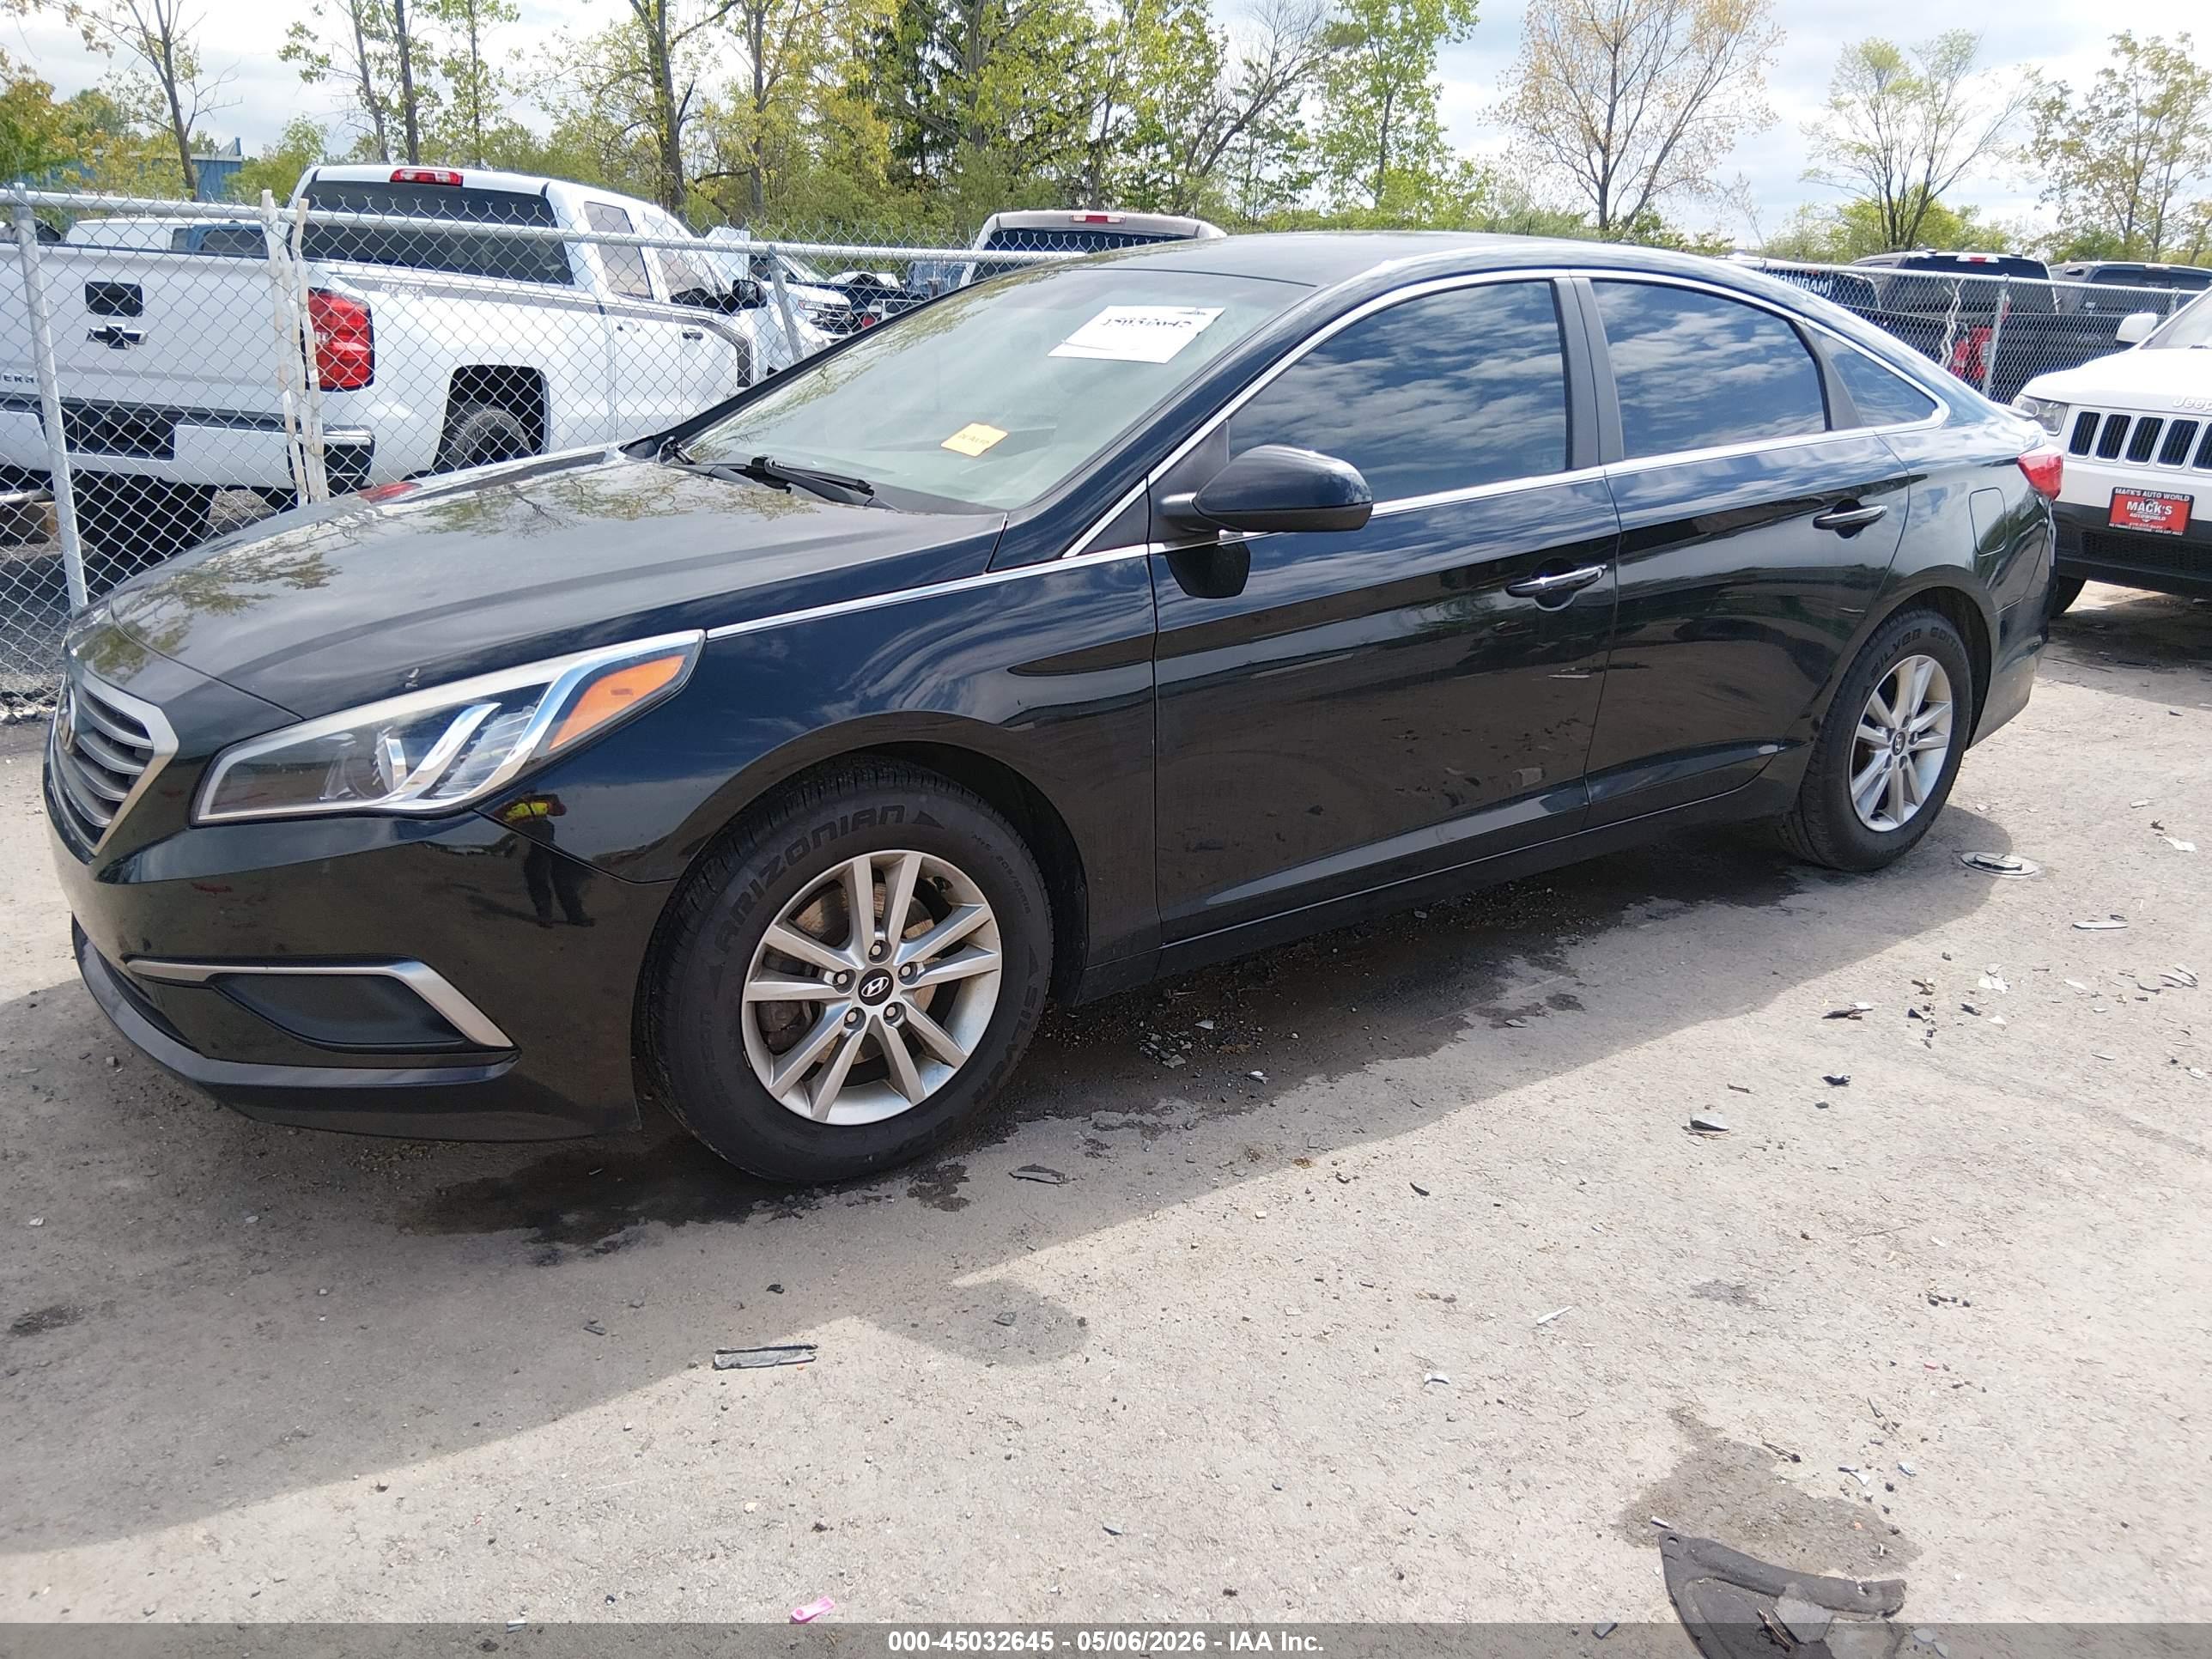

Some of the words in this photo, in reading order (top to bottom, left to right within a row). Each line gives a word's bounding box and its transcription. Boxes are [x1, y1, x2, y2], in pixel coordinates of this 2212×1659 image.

[2115, 488, 2142, 496] MACK'S
[2163, 493, 2190, 502] WORLD
[2126, 501, 2173, 515] MACK'S
[1870, 628, 1922, 681] SILVER
[714, 804, 906, 951] ARIZONIAN
